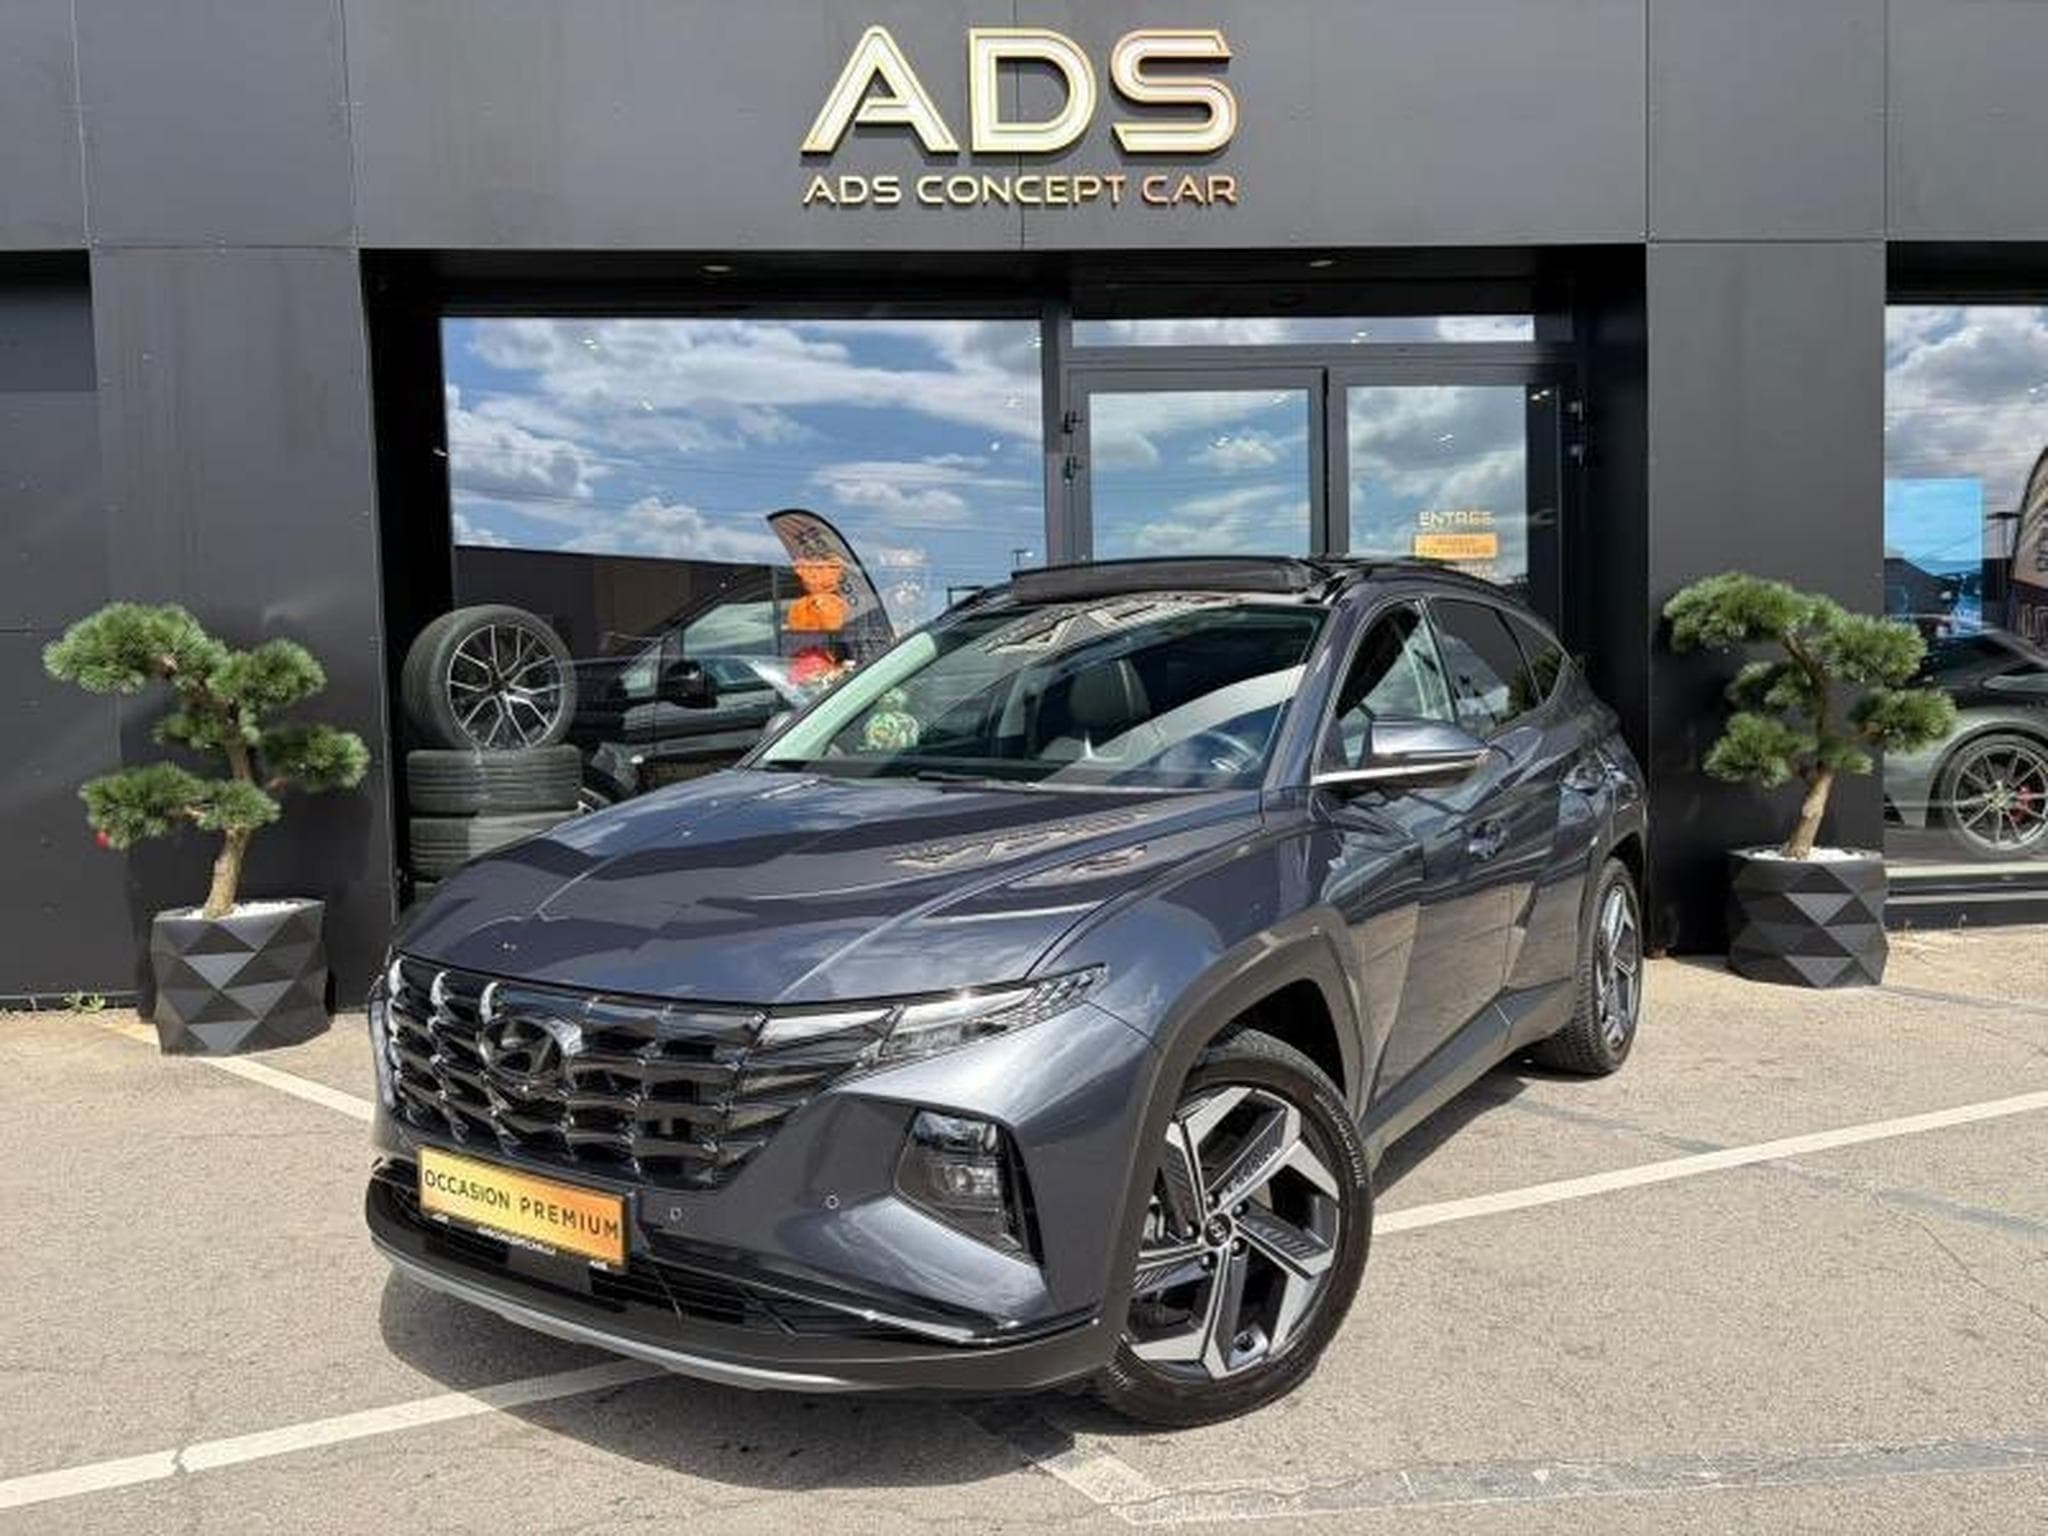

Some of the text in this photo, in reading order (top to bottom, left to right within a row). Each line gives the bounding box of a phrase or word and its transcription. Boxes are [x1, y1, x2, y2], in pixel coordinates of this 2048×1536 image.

[800, 25, 1238, 154] ADS
[803, 174, 1238, 205] ADS CONCEPT CAR
[424, 1168, 619, 1240] OCCASION PREMIUM
